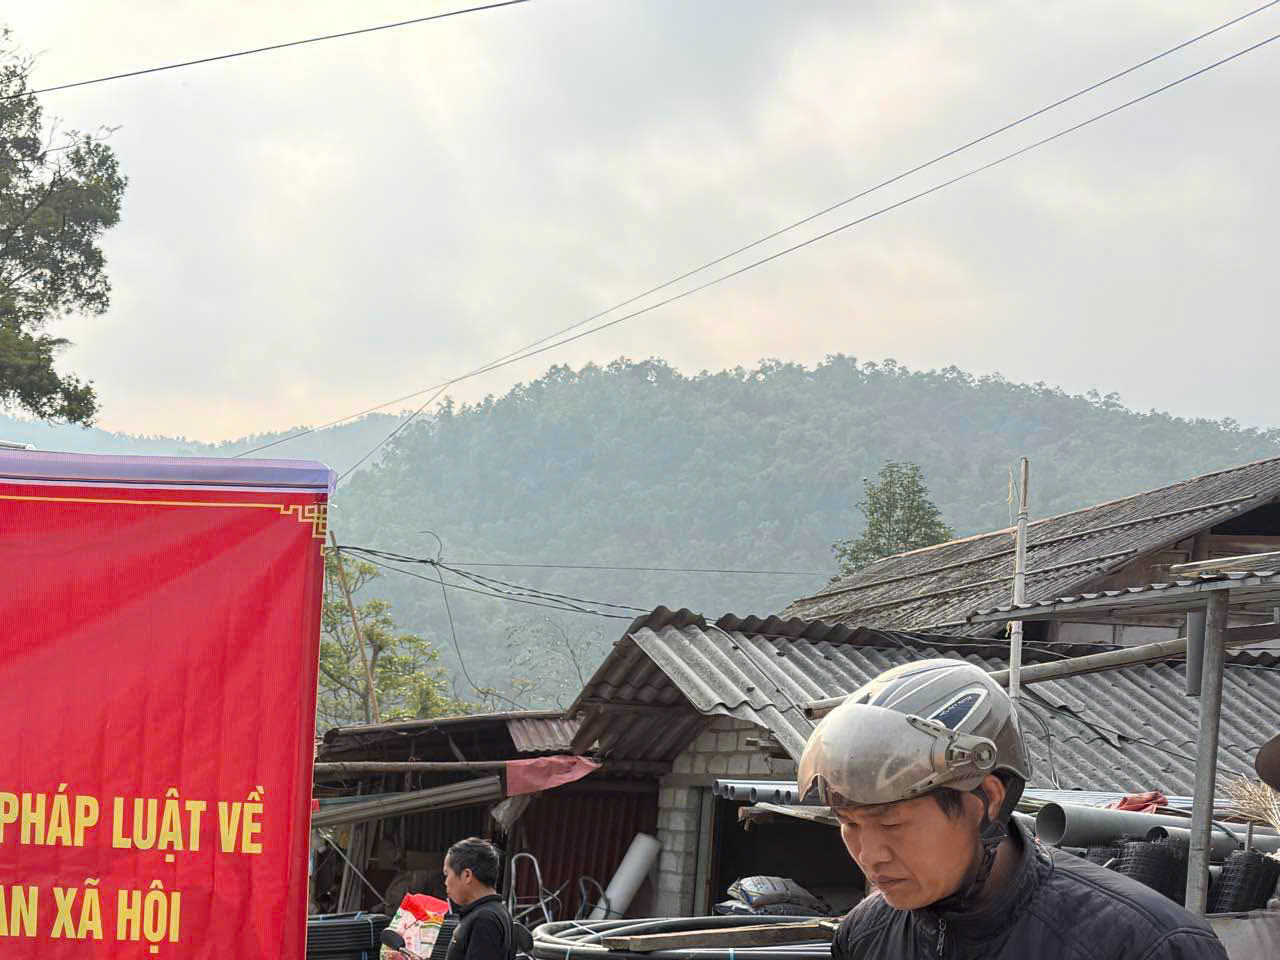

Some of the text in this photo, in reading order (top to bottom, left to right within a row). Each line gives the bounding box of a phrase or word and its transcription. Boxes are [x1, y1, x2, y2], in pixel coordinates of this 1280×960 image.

[112, 787, 208, 863] LUẬT
[218, 785, 266, 854] VỀ
[50, 879, 104, 941] XÃ
[116, 879, 181, 954] HỘI
